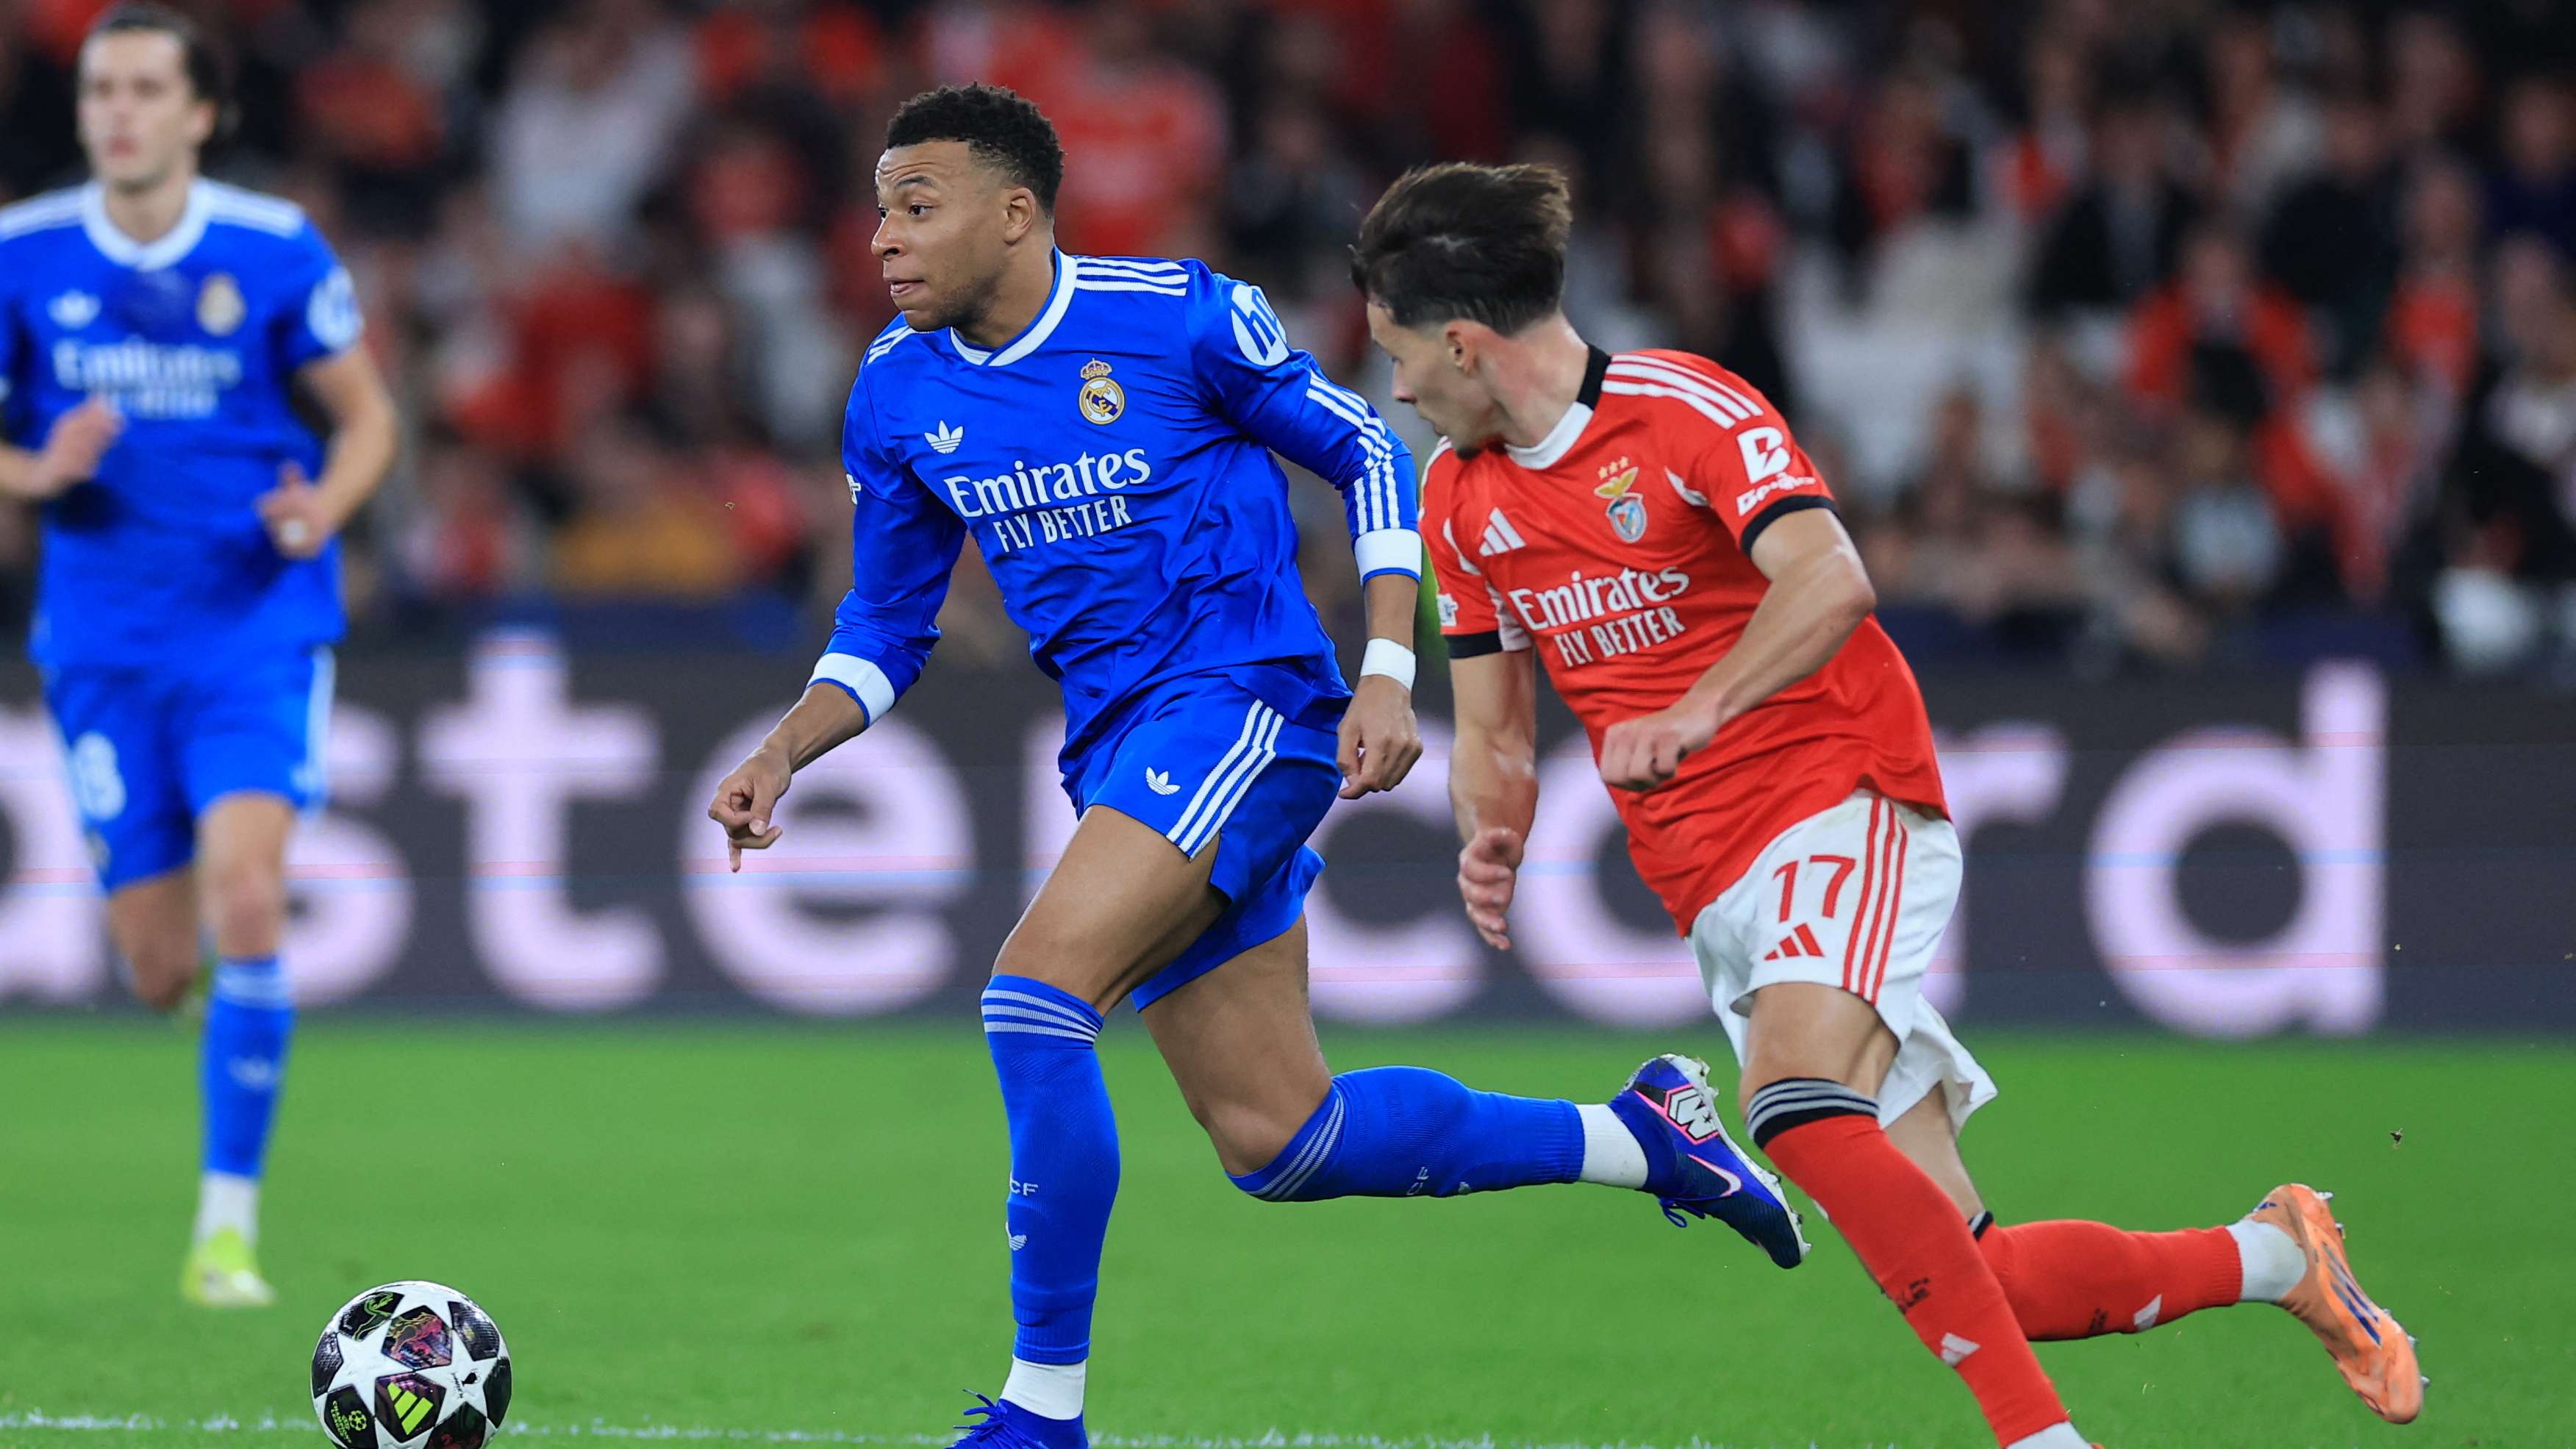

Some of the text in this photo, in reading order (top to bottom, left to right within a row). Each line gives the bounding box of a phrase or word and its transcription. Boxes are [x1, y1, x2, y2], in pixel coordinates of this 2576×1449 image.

[943, 448, 1151, 518] Emirates
[992, 495, 1132, 553] FLY BETTER
[1508, 565, 1690, 631] Emirates
[1554, 605, 1686, 668] FLY BETTER
[1772, 854, 1856, 923] 17
